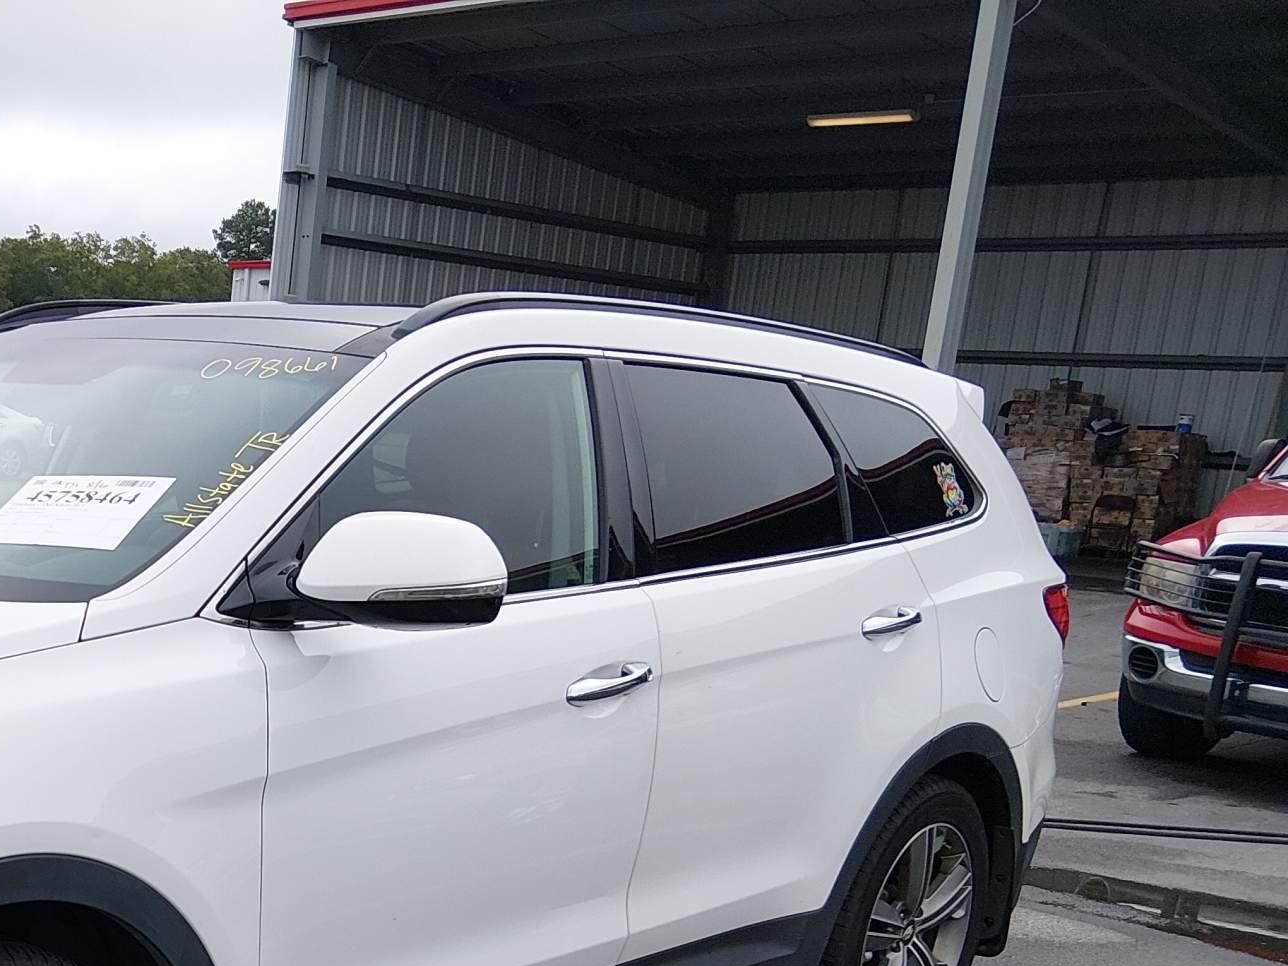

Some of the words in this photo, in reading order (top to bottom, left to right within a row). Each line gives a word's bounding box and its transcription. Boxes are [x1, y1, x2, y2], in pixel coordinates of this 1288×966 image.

[26, 490, 142, 505] 45758464
[162, 462, 254, 528] Allstate
[235, 431, 290, 458] TR
